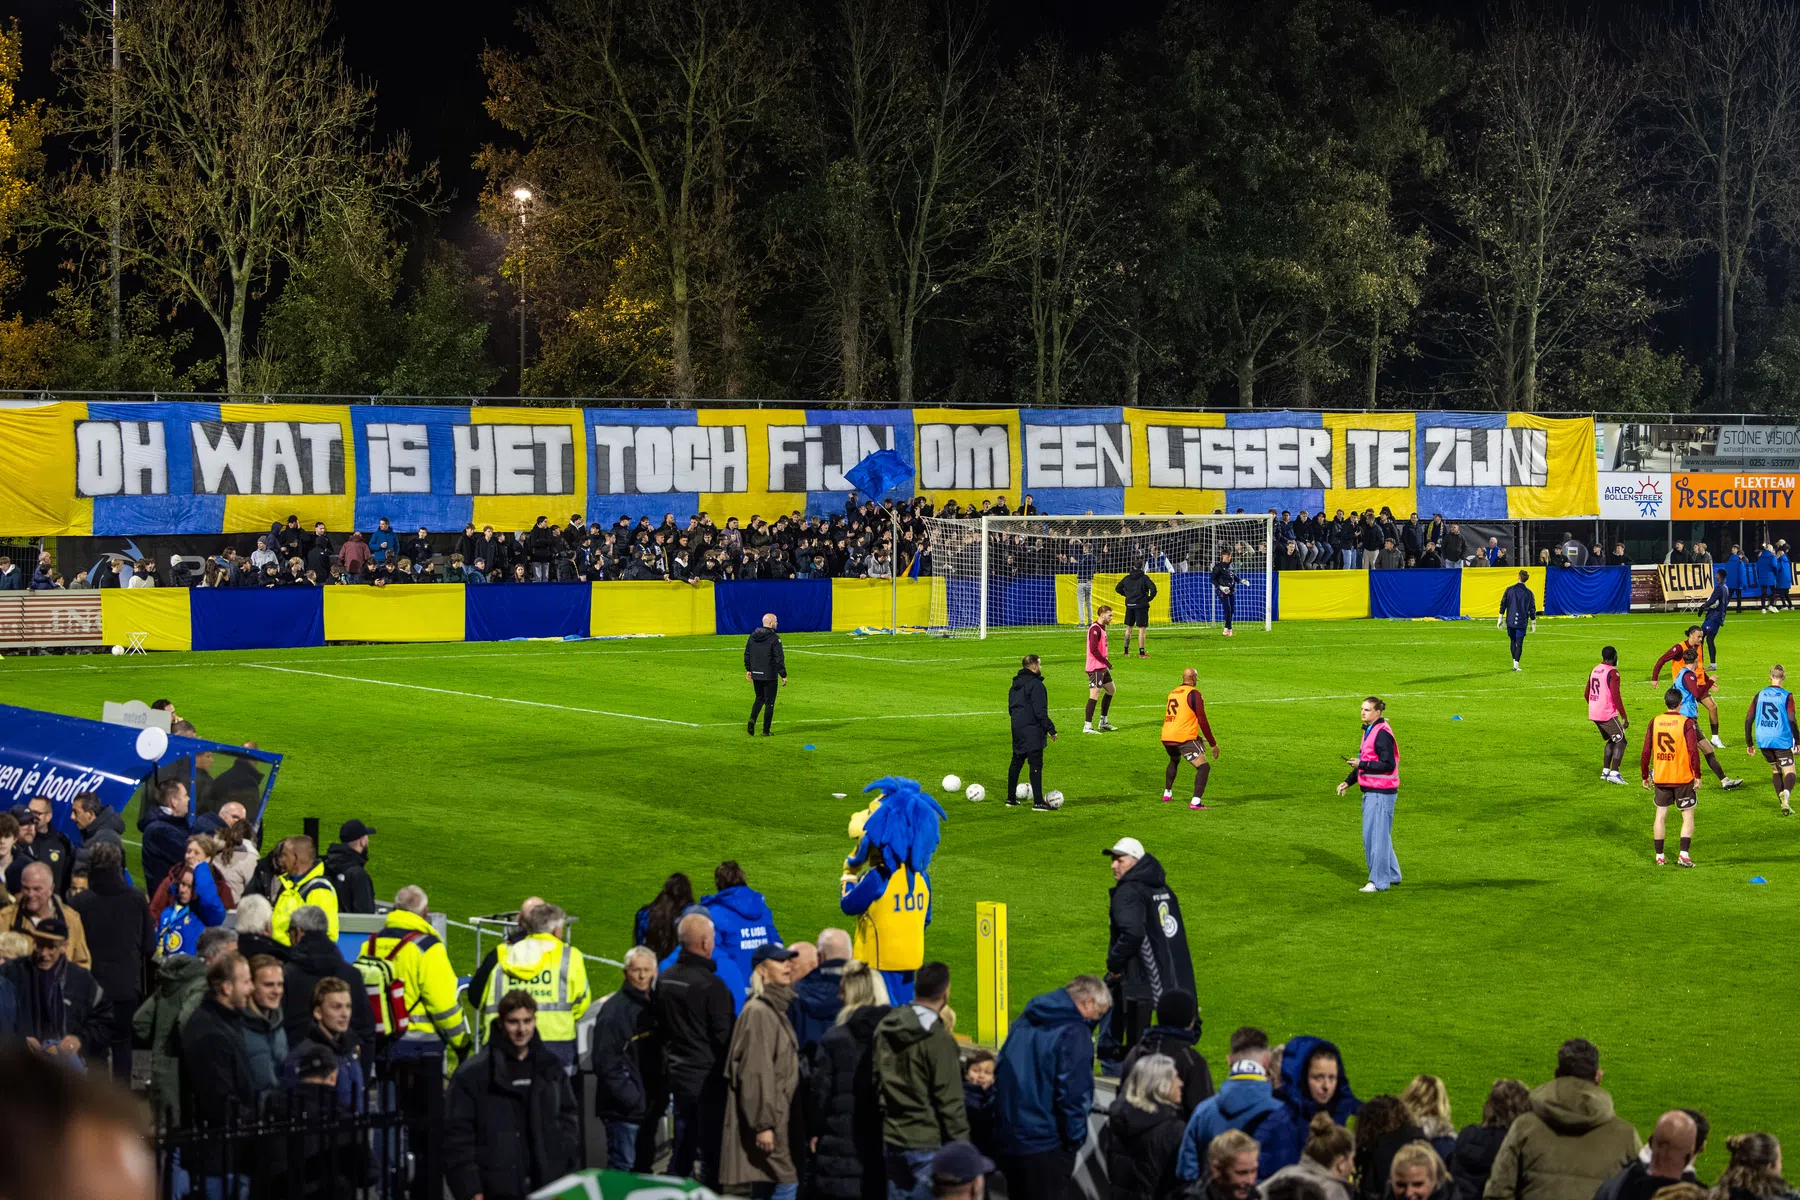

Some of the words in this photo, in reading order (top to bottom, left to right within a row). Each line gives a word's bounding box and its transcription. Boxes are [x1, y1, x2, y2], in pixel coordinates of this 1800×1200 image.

[1723, 430, 1762, 445] STONE
[75, 420, 169, 497] OH
[191, 420, 345, 495] WAT
[453, 424, 575, 495] HET
[595, 425, 748, 493] TOCH
[918, 424, 1010, 489] OM
[1025, 424, 1132, 488] EEN
[1346, 429, 1410, 488] TE
[1685, 457, 1744, 466] www.stonevisions.nl
[1749, 458, 1766, 467] 0252
[1771, 459, 1795, 467] 533777
[1604, 486, 1634, 494] AIRCO
[1734, 476, 1795, 489] FLEXTEAM
[1697, 489, 1795, 508] SECURITY
[1658, 563, 1714, 592] YELLOW
[50, 609, 102, 632] IN
[1761, 720, 1778, 728] ROBEY
[1656, 753, 1675, 762] ROBEY
[13, 763, 41, 801] je
[893, 893, 925, 912] 100
